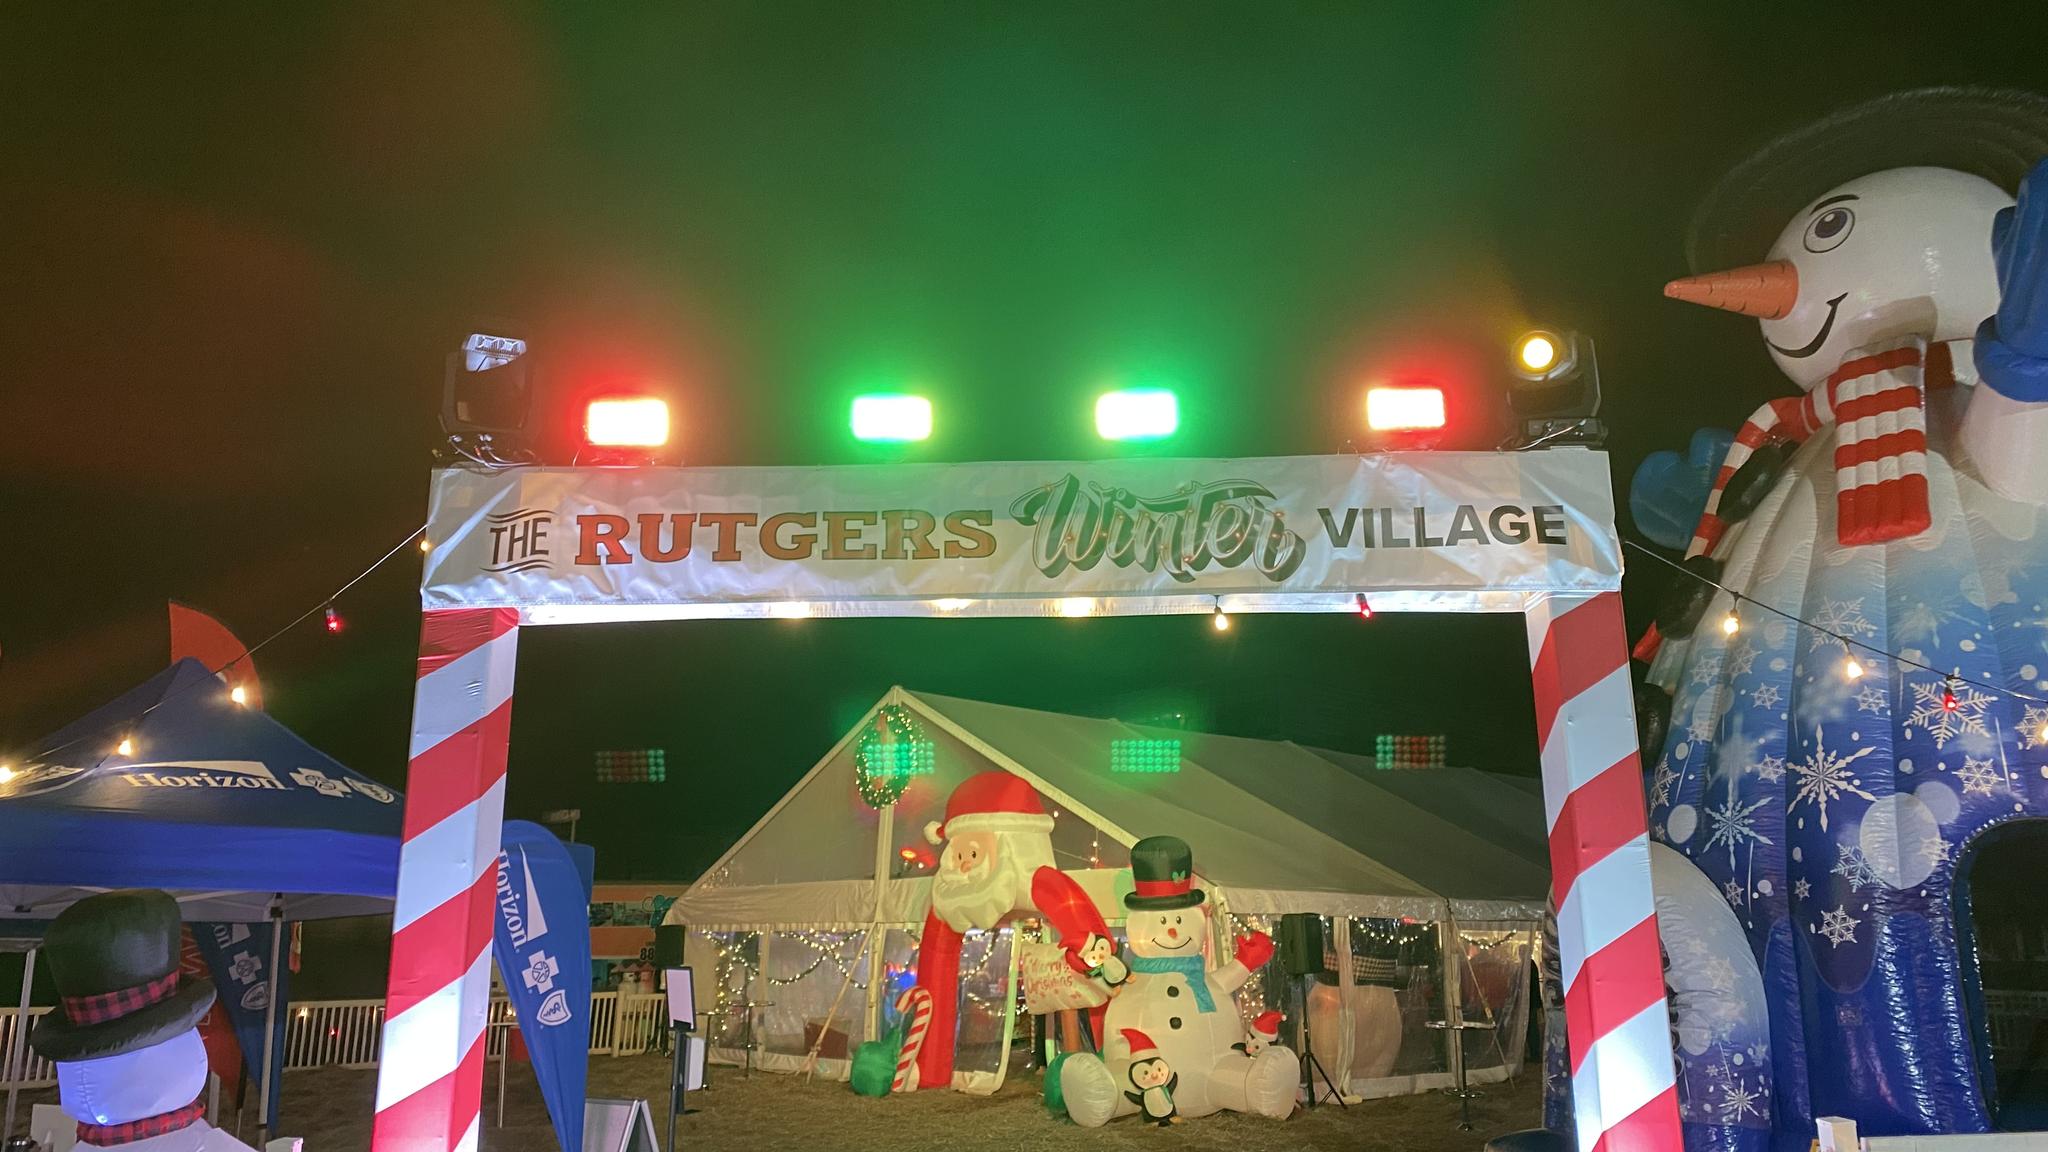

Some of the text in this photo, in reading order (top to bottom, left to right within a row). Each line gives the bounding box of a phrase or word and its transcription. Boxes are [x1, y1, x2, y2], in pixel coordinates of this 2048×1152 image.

[489, 472, 1567, 582] THE RUTGERS Winter VILLAGE
[121, 772, 287, 791] Horizon
